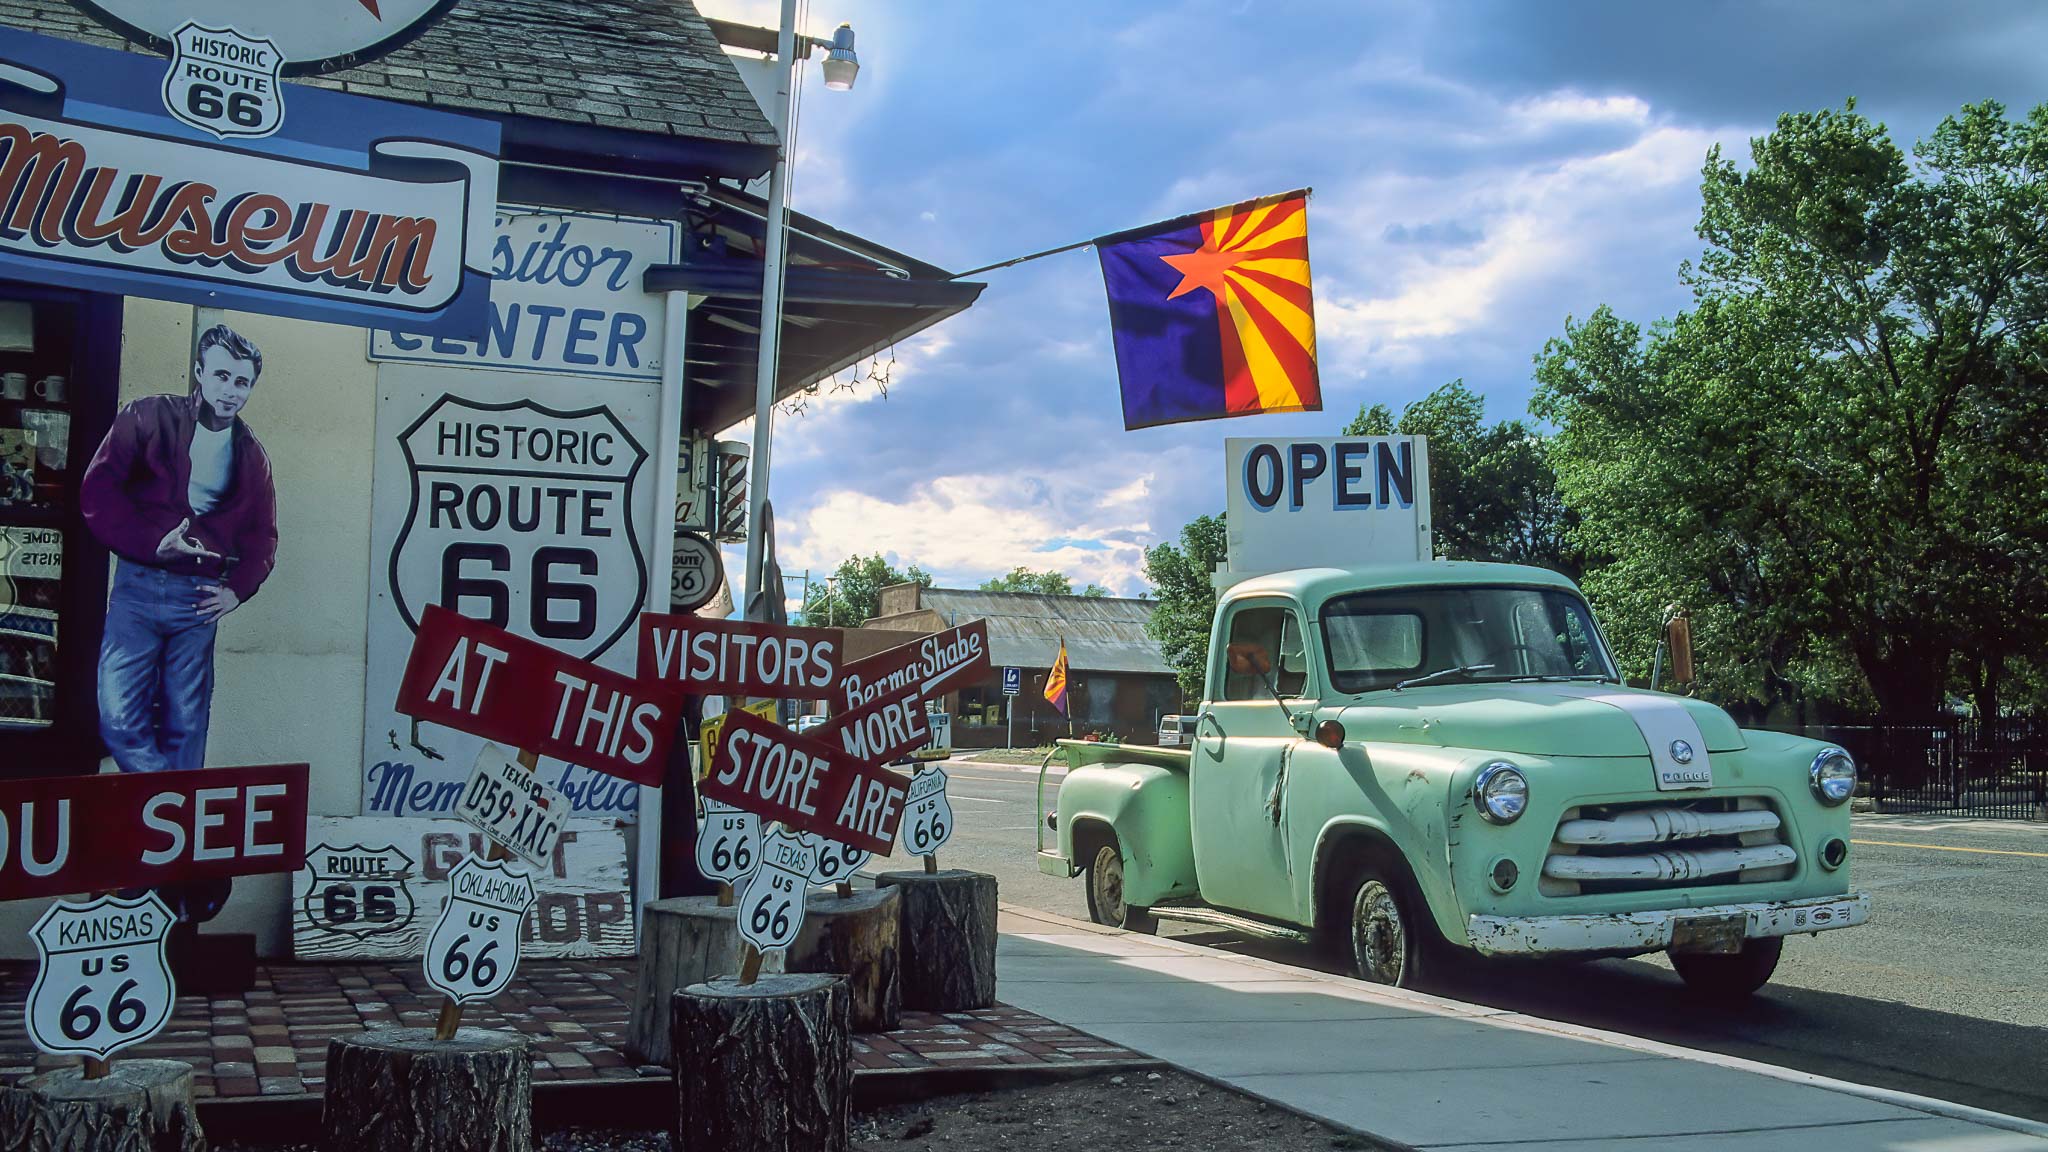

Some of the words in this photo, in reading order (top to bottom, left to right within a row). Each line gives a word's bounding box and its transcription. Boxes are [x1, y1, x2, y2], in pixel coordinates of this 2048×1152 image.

[192, 36, 267, 68] HISTORIC
[186, 63, 267, 93] ROUTE
[187, 83, 263, 127] 66
[0, 123, 437, 295] Museum
[492, 219, 632, 291] sitor
[437, 421, 614, 466] HISTORIC
[1241, 441, 1413, 512] OPEN
[429, 481, 612, 537] ROUTE
[673, 555, 700, 566] OUTE
[440, 542, 598, 640] 66
[652, 627, 834, 688] VISITORS
[427, 636, 509, 715] AT
[551, 671, 661, 764] THIS
[840, 693, 926, 760] MORE
[466, 772, 514, 825] D59
[502, 763, 532, 793] TEXAS
[717, 728, 830, 816] STORE
[835, 774, 904, 842] ARE
[141, 784, 286, 865] SEE
[723, 818, 745, 831] US
[917, 800, 935, 814] US
[914, 812, 944, 848] 66
[327, 856, 388, 874] ROUTE
[421, 832, 577, 880] GIT
[711, 835, 750, 872] 66
[775, 843, 807, 871] TEXAS
[818, 843, 862, 877] 66
[323, 885, 396, 923] 66
[460, 872, 526, 906] OKLAHOMA
[772, 875, 794, 893] US
[59, 912, 153, 945] KANSAS
[468, 911, 500, 932] US
[751, 894, 790, 940] 66
[81, 954, 129, 976] US
[443, 934, 498, 987] 66
[60, 979, 146, 1041] 66
